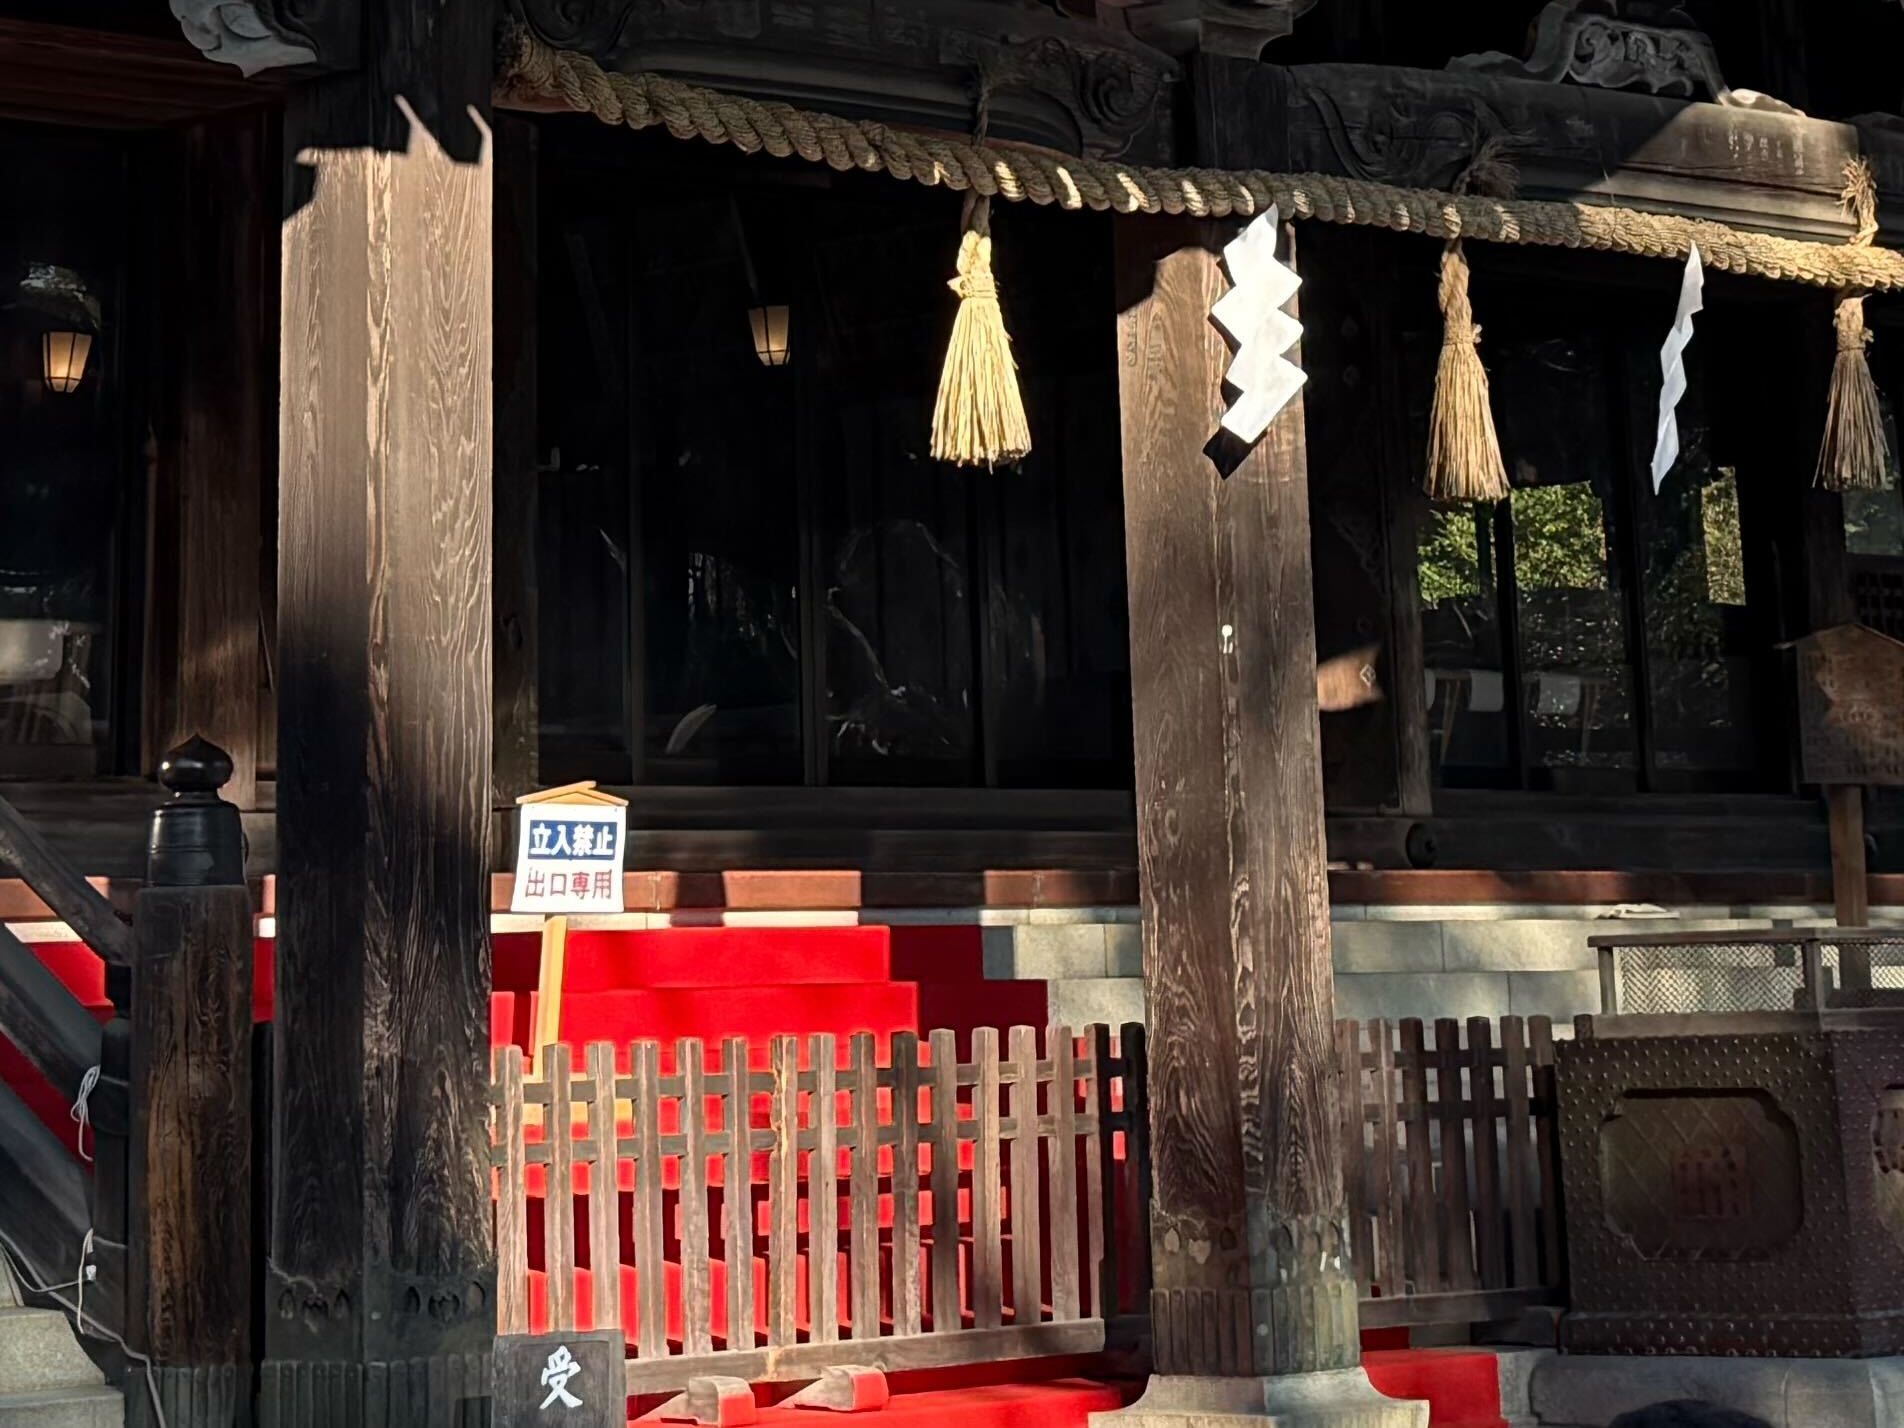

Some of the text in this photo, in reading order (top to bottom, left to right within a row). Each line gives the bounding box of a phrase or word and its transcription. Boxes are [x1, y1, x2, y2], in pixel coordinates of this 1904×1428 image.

[530, 823, 614, 857] 立入禁止
[525, 867, 612, 900] 出口専用
[539, 1345, 583, 1409] 受
